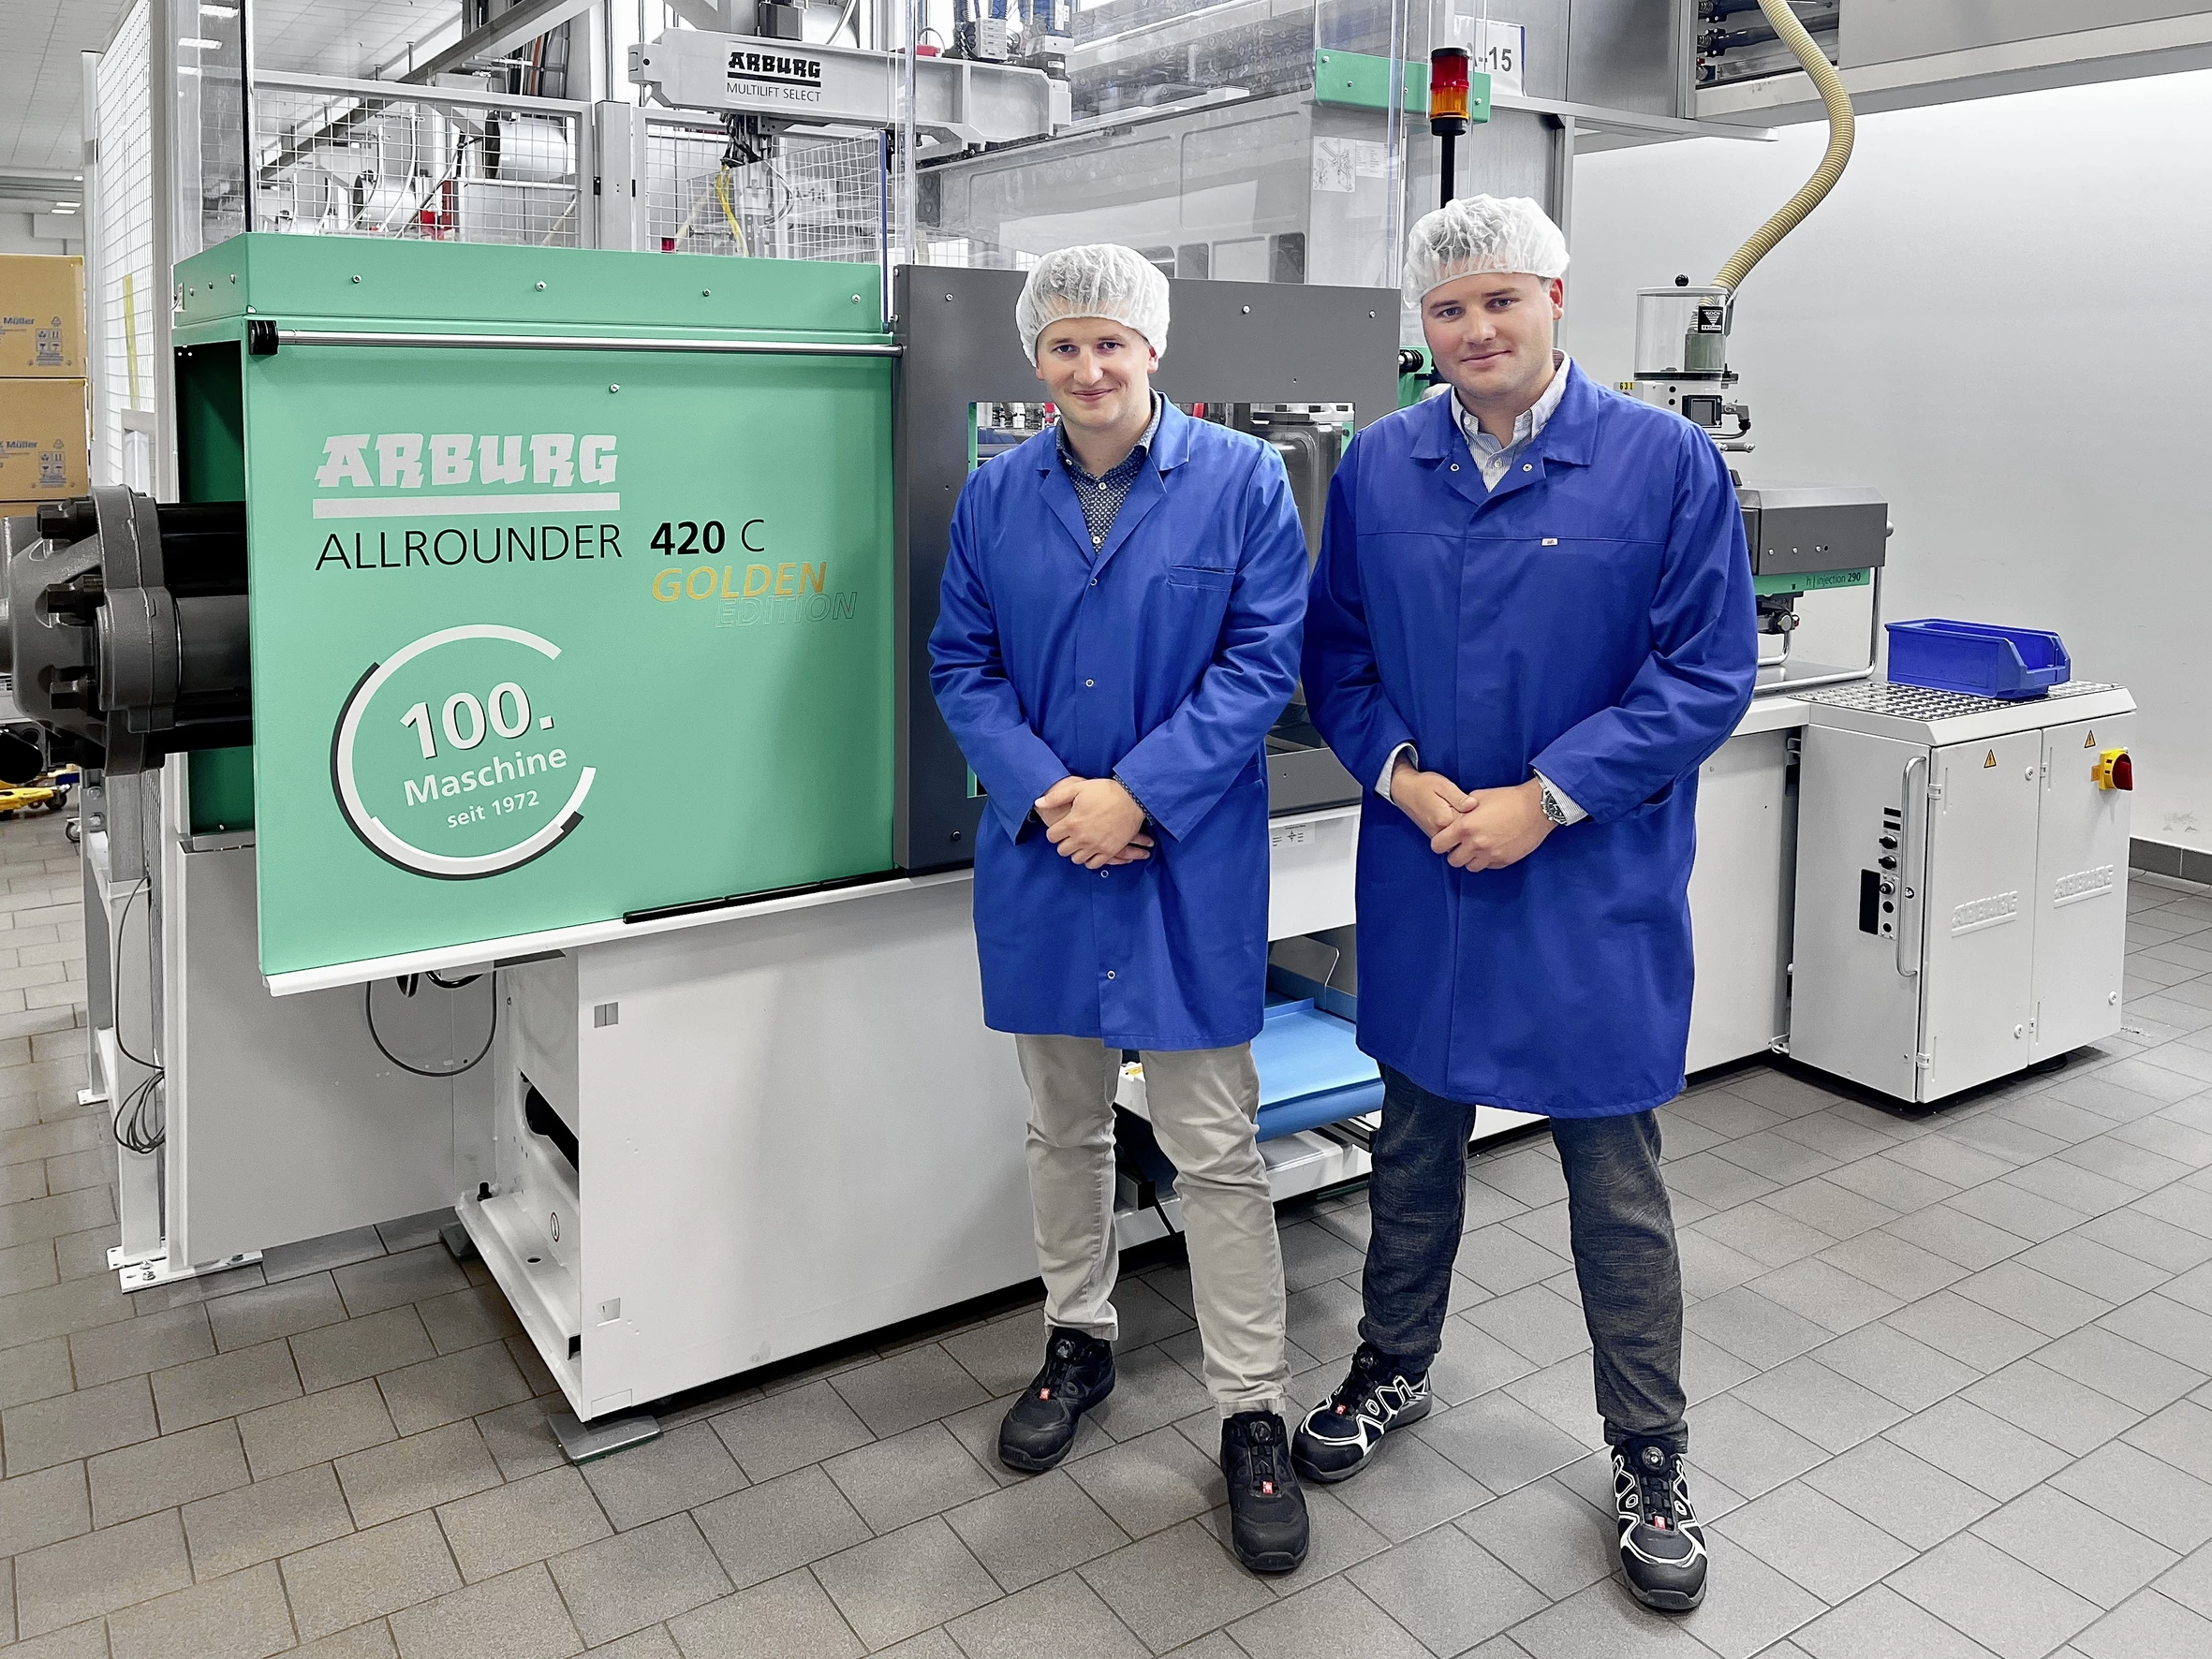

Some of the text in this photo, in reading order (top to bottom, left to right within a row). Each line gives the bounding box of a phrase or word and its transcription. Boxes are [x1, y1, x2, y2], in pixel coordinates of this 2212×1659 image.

[728, 51, 820, 79] ARBURG
[727, 82, 821, 102] MULTILIFT SELECT
[314, 433, 618, 488] ARBURG
[315, 519, 765, 571] ALLROUNDER 420 C
[652, 562, 827, 602] GOLDEN
[1817, 574, 1846, 587] injection
[1847, 572, 1861, 582] 290
[715, 591, 858, 628] EDITION
[399, 682, 554, 759] 100.
[404, 748, 567, 806] Maschine
[447, 790, 539, 829] seit 1972
